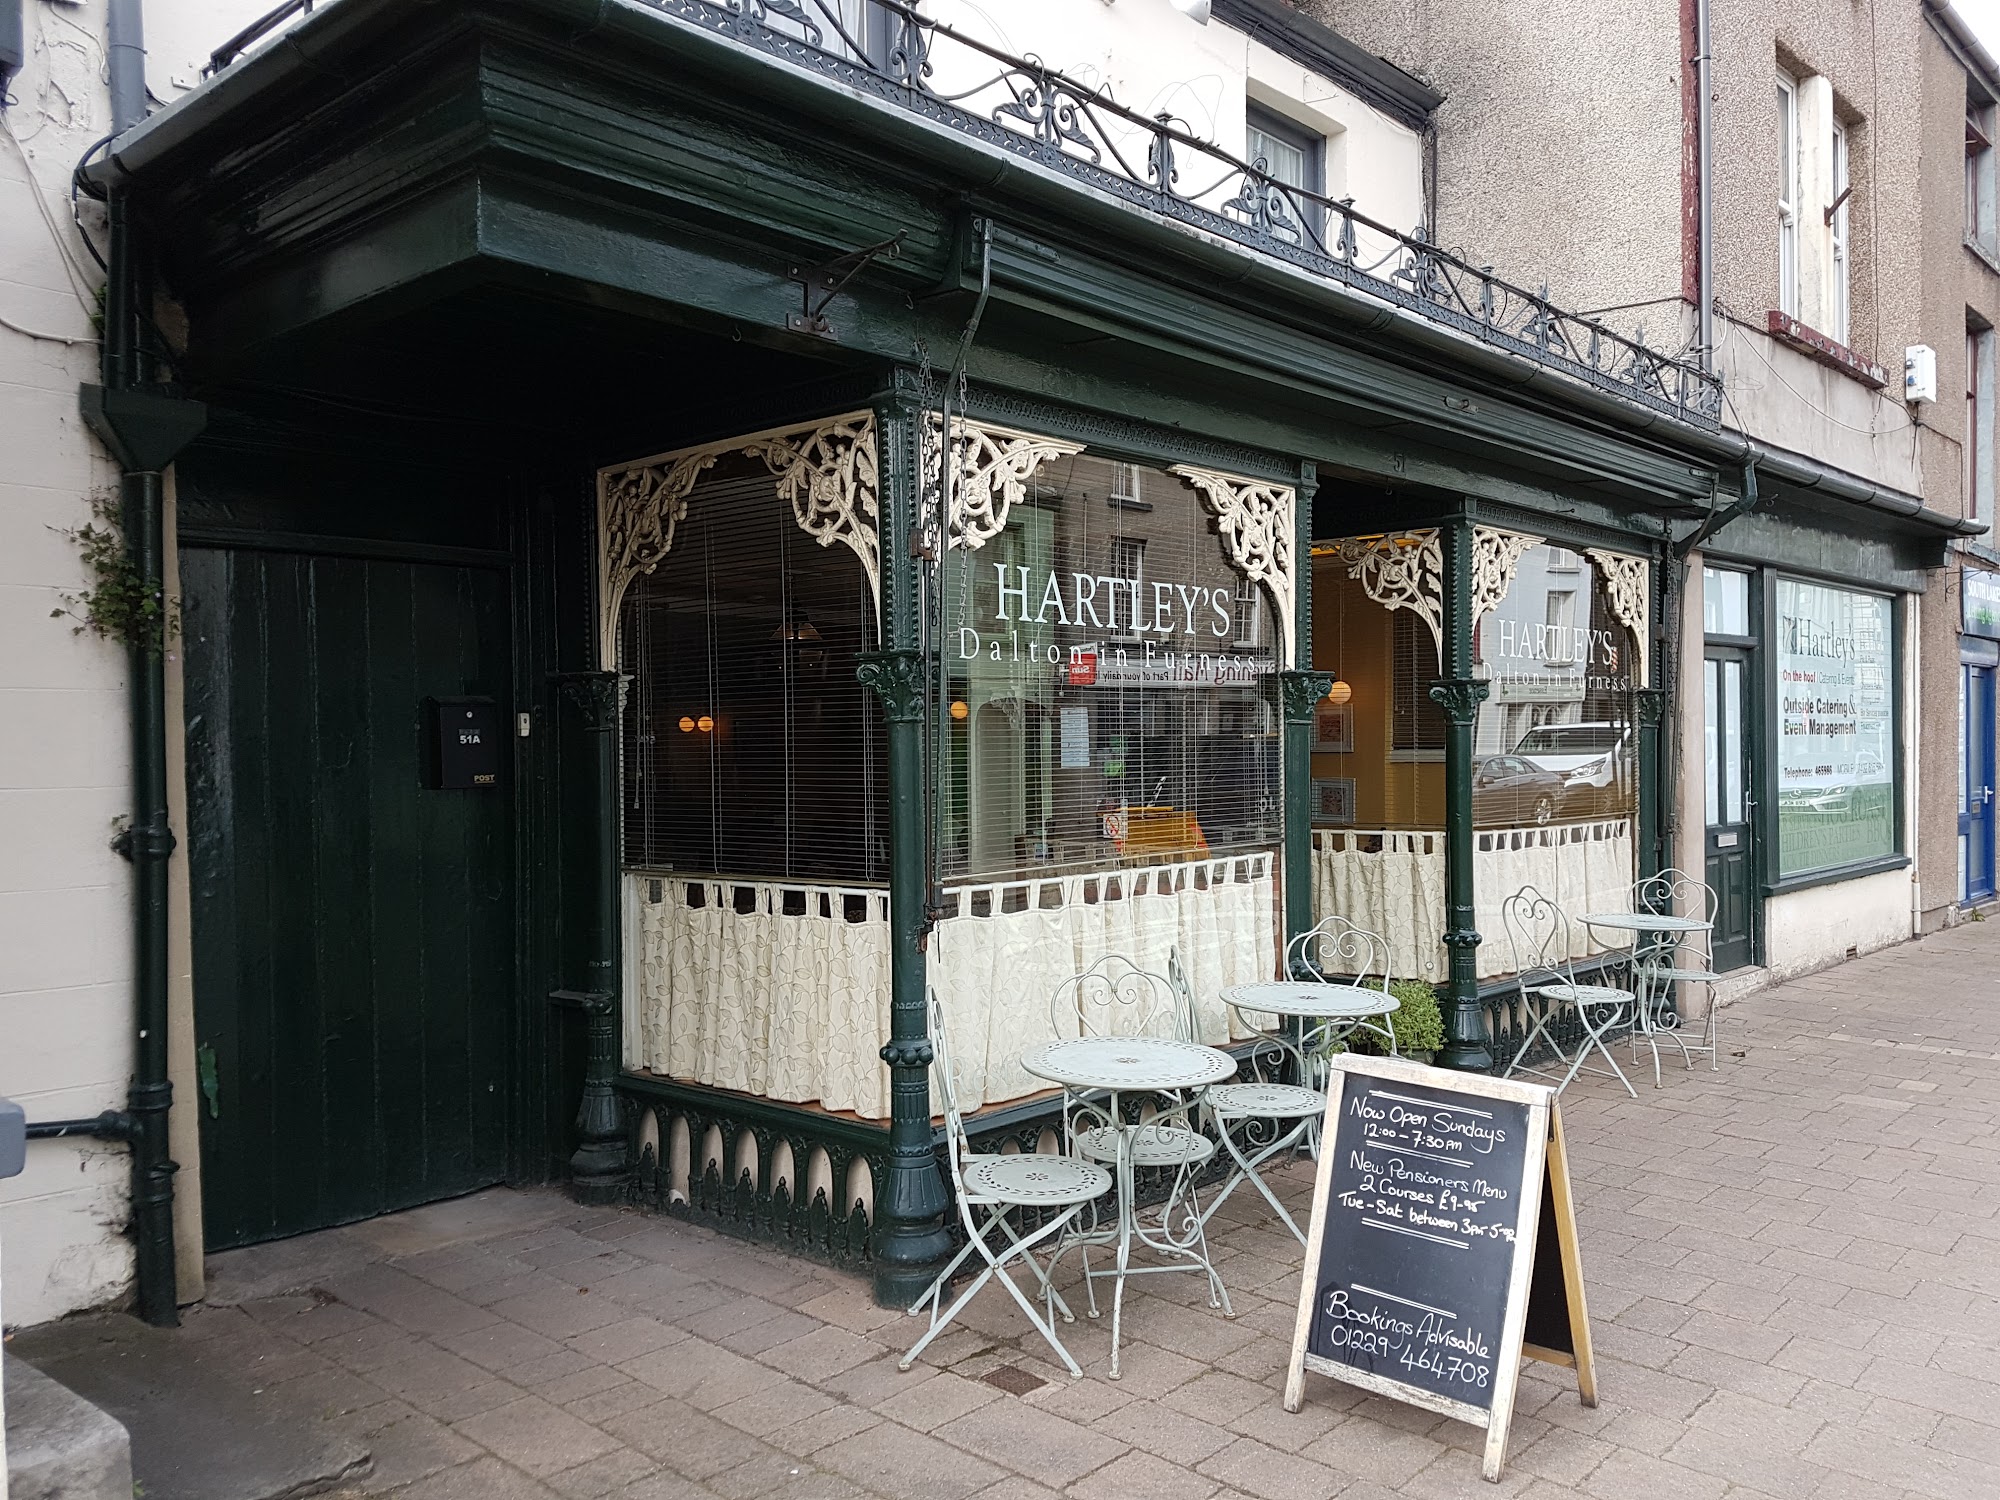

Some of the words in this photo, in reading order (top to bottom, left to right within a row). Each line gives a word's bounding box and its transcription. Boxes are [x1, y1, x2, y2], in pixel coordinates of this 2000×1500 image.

[993, 562, 1230, 638] HARTLEY'S
[1968, 580, 1986, 599] SOUTH
[959, 627, 1083, 665] Dalton
[1100, 640, 1128, 667] in
[1144, 640, 1255, 673] Furness
[1499, 619, 1613, 666] HARTLEY'S
[1798, 617, 1855, 668] Hartley's
[1483, 662, 1540, 686] Dalton
[1547, 669, 1561, 687] in
[1568, 668, 1627, 691] Furness
[1783, 669, 1792, 681] On
[1792, 670, 1803, 682] the
[1783, 696, 1814, 714] Outside
[1816, 697, 1848, 718] Catering
[1848, 694, 1857, 715] &
[459, 735, 481, 744] 51A
[1784, 718, 1807, 736] Event
[1808, 718, 1856, 739] Management
[473, 774, 495, 782] POST
[1350, 1096, 1386, 1120] Now
[1389, 1105, 1428, 1129] Open
[1431, 1112, 1506, 1154] Sundays
[1363, 1123, 1396, 1138] 12:00
[1350, 1150, 1384, 1175] New
[1388, 1158, 1469, 1192] Pensioners
[1472, 1179, 1508, 1200] Menu
[1359, 1174, 1377, 1192] 2
[1379, 1178, 1434, 1205] Courses
[1409, 1208, 1458, 1232] between
[1326, 1290, 1414, 1350] Bookings
[1416, 1312, 1491, 1360] Advisable
[1331, 1324, 1389, 1358] 01229
[1400, 1343, 1491, 1388] 464708
